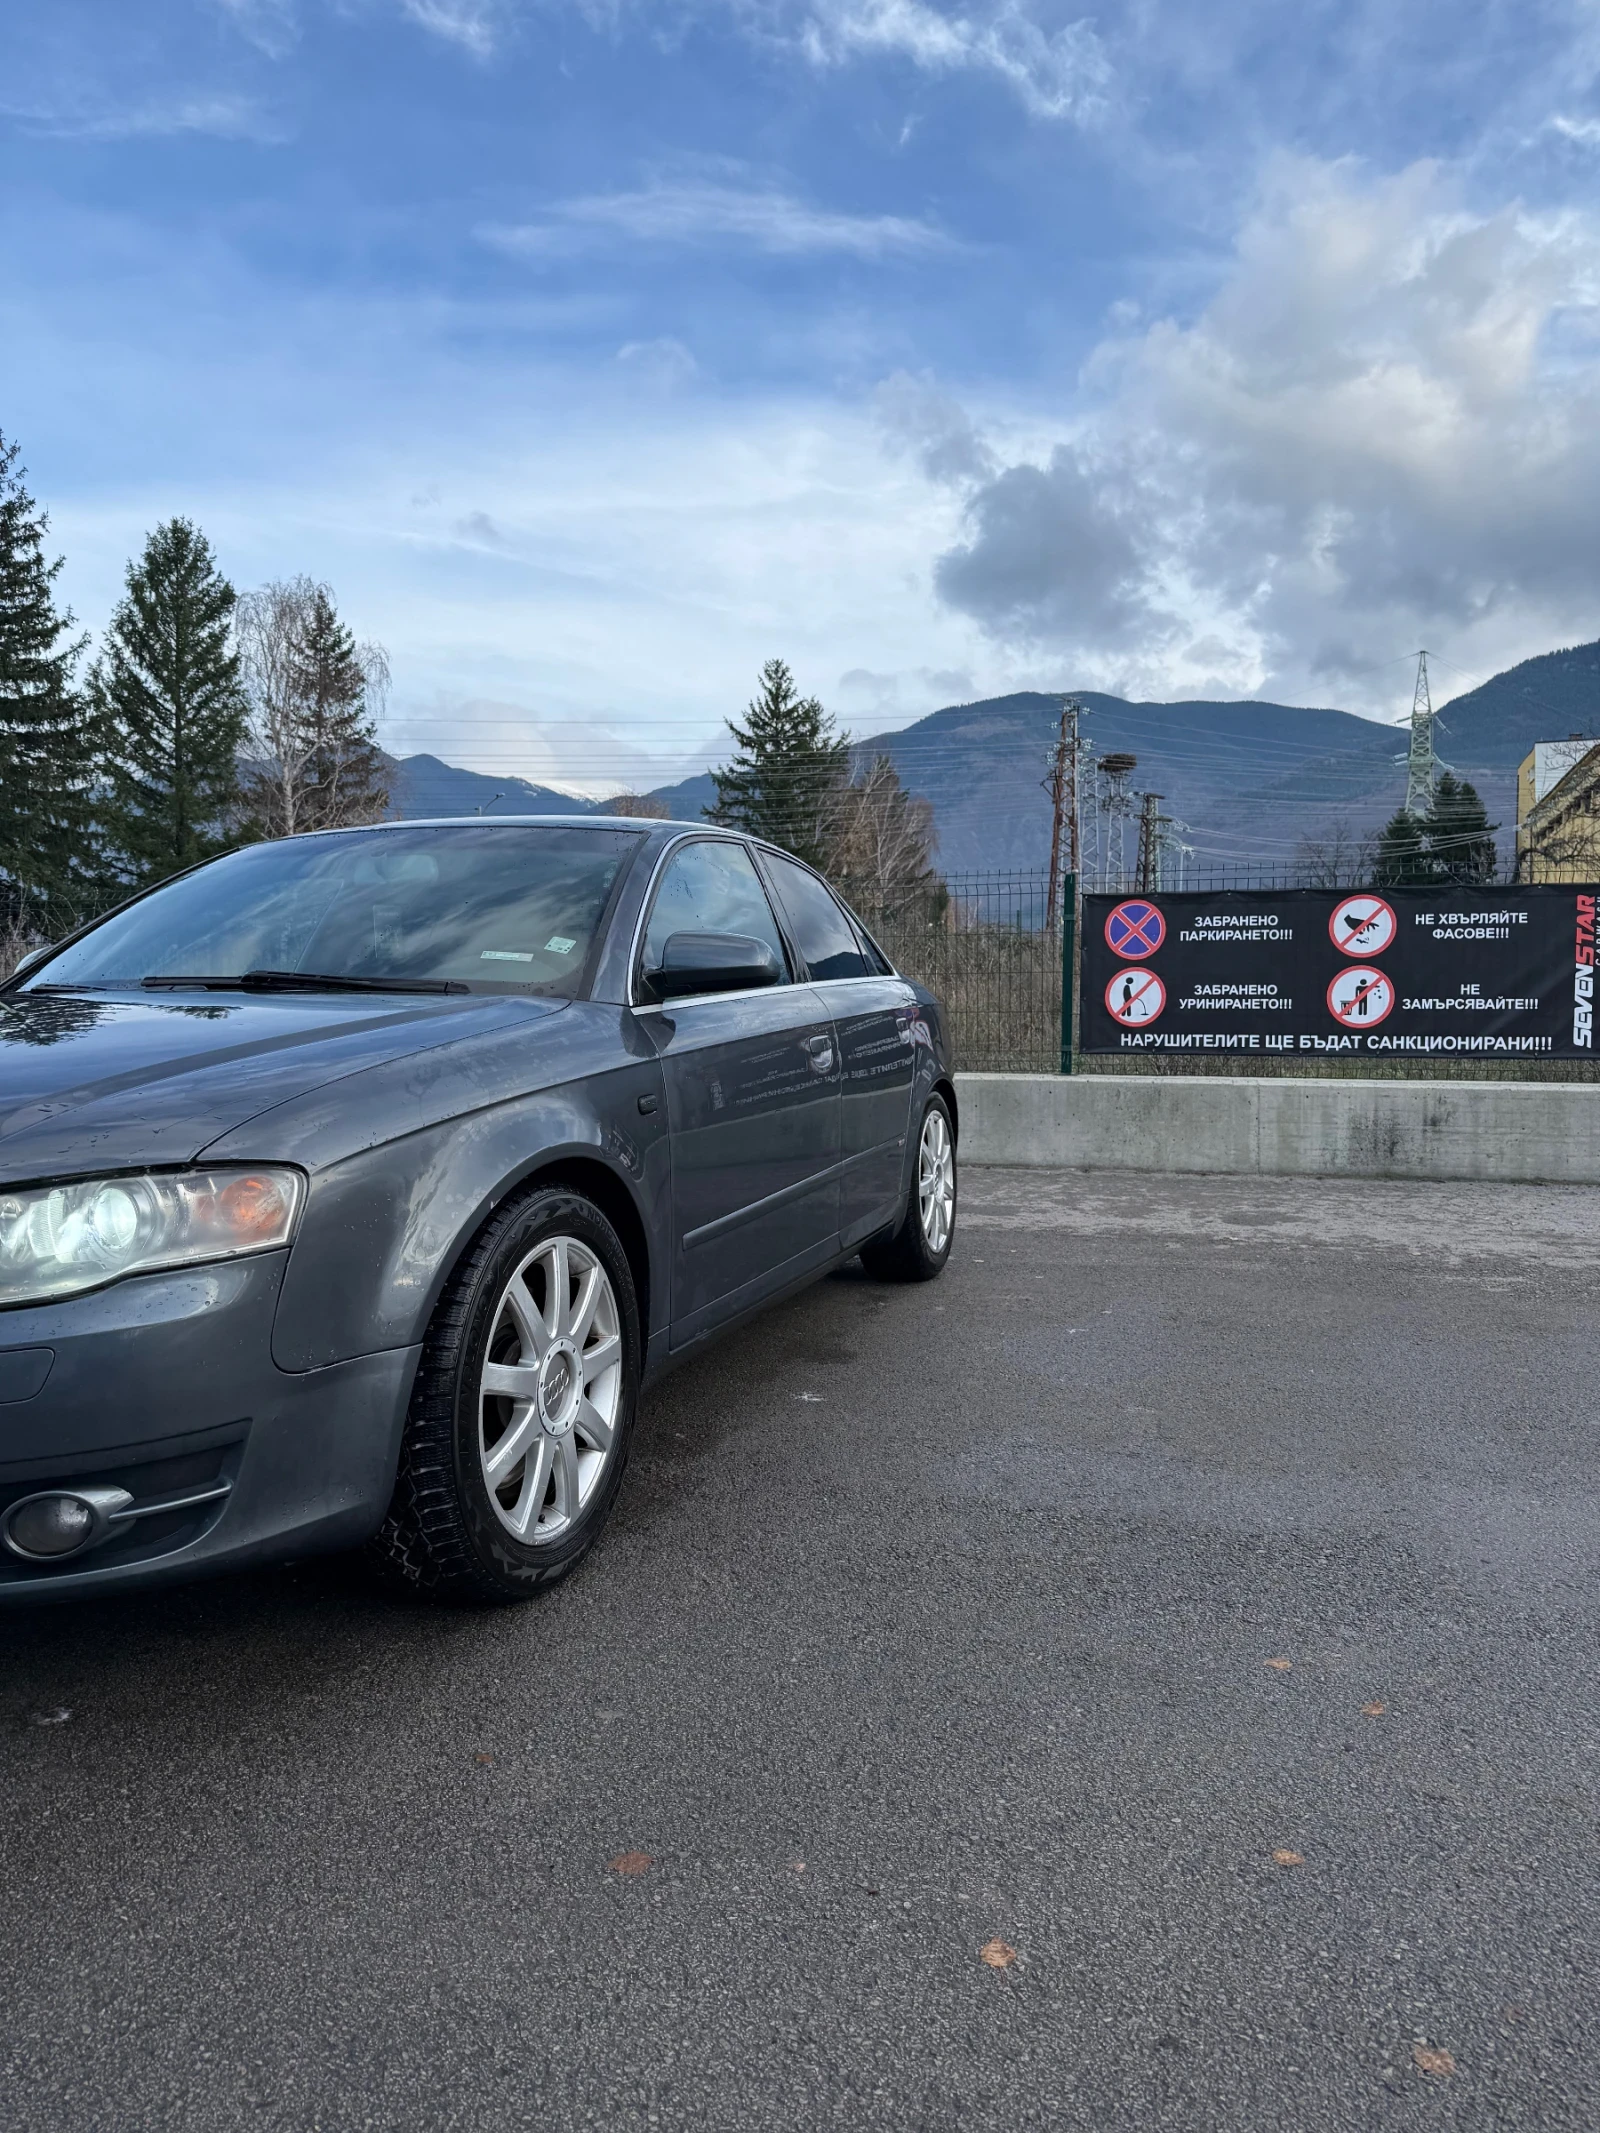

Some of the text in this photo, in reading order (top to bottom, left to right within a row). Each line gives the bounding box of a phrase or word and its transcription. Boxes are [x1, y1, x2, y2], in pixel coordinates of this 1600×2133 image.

[1194, 915, 1279, 927] ЗАБРАНЕНО
[1415, 909, 1528, 925] НЕ ХВЪРЛЯЙТЕ
[1180, 929, 1293, 942] ПАРКИРАНЕТО!!!
[1432, 927, 1509, 940] ФАСОВЕ!!!
[1193, 984, 1278, 996] ЗАБРАНЕНО
[1460, 983, 1481, 995] НЕ
[1179, 998, 1292, 1010] УРИНИРАНЕТО!!!
[1402, 995, 1539, 1010] ЗАМЪРСЯВАЙТЕ!!!
[1120, 1033, 1552, 1052] НАРУШИТЕЛИТЕ ЩЕ БЪДАТ САНКЦИОНИРАНИ!!!
